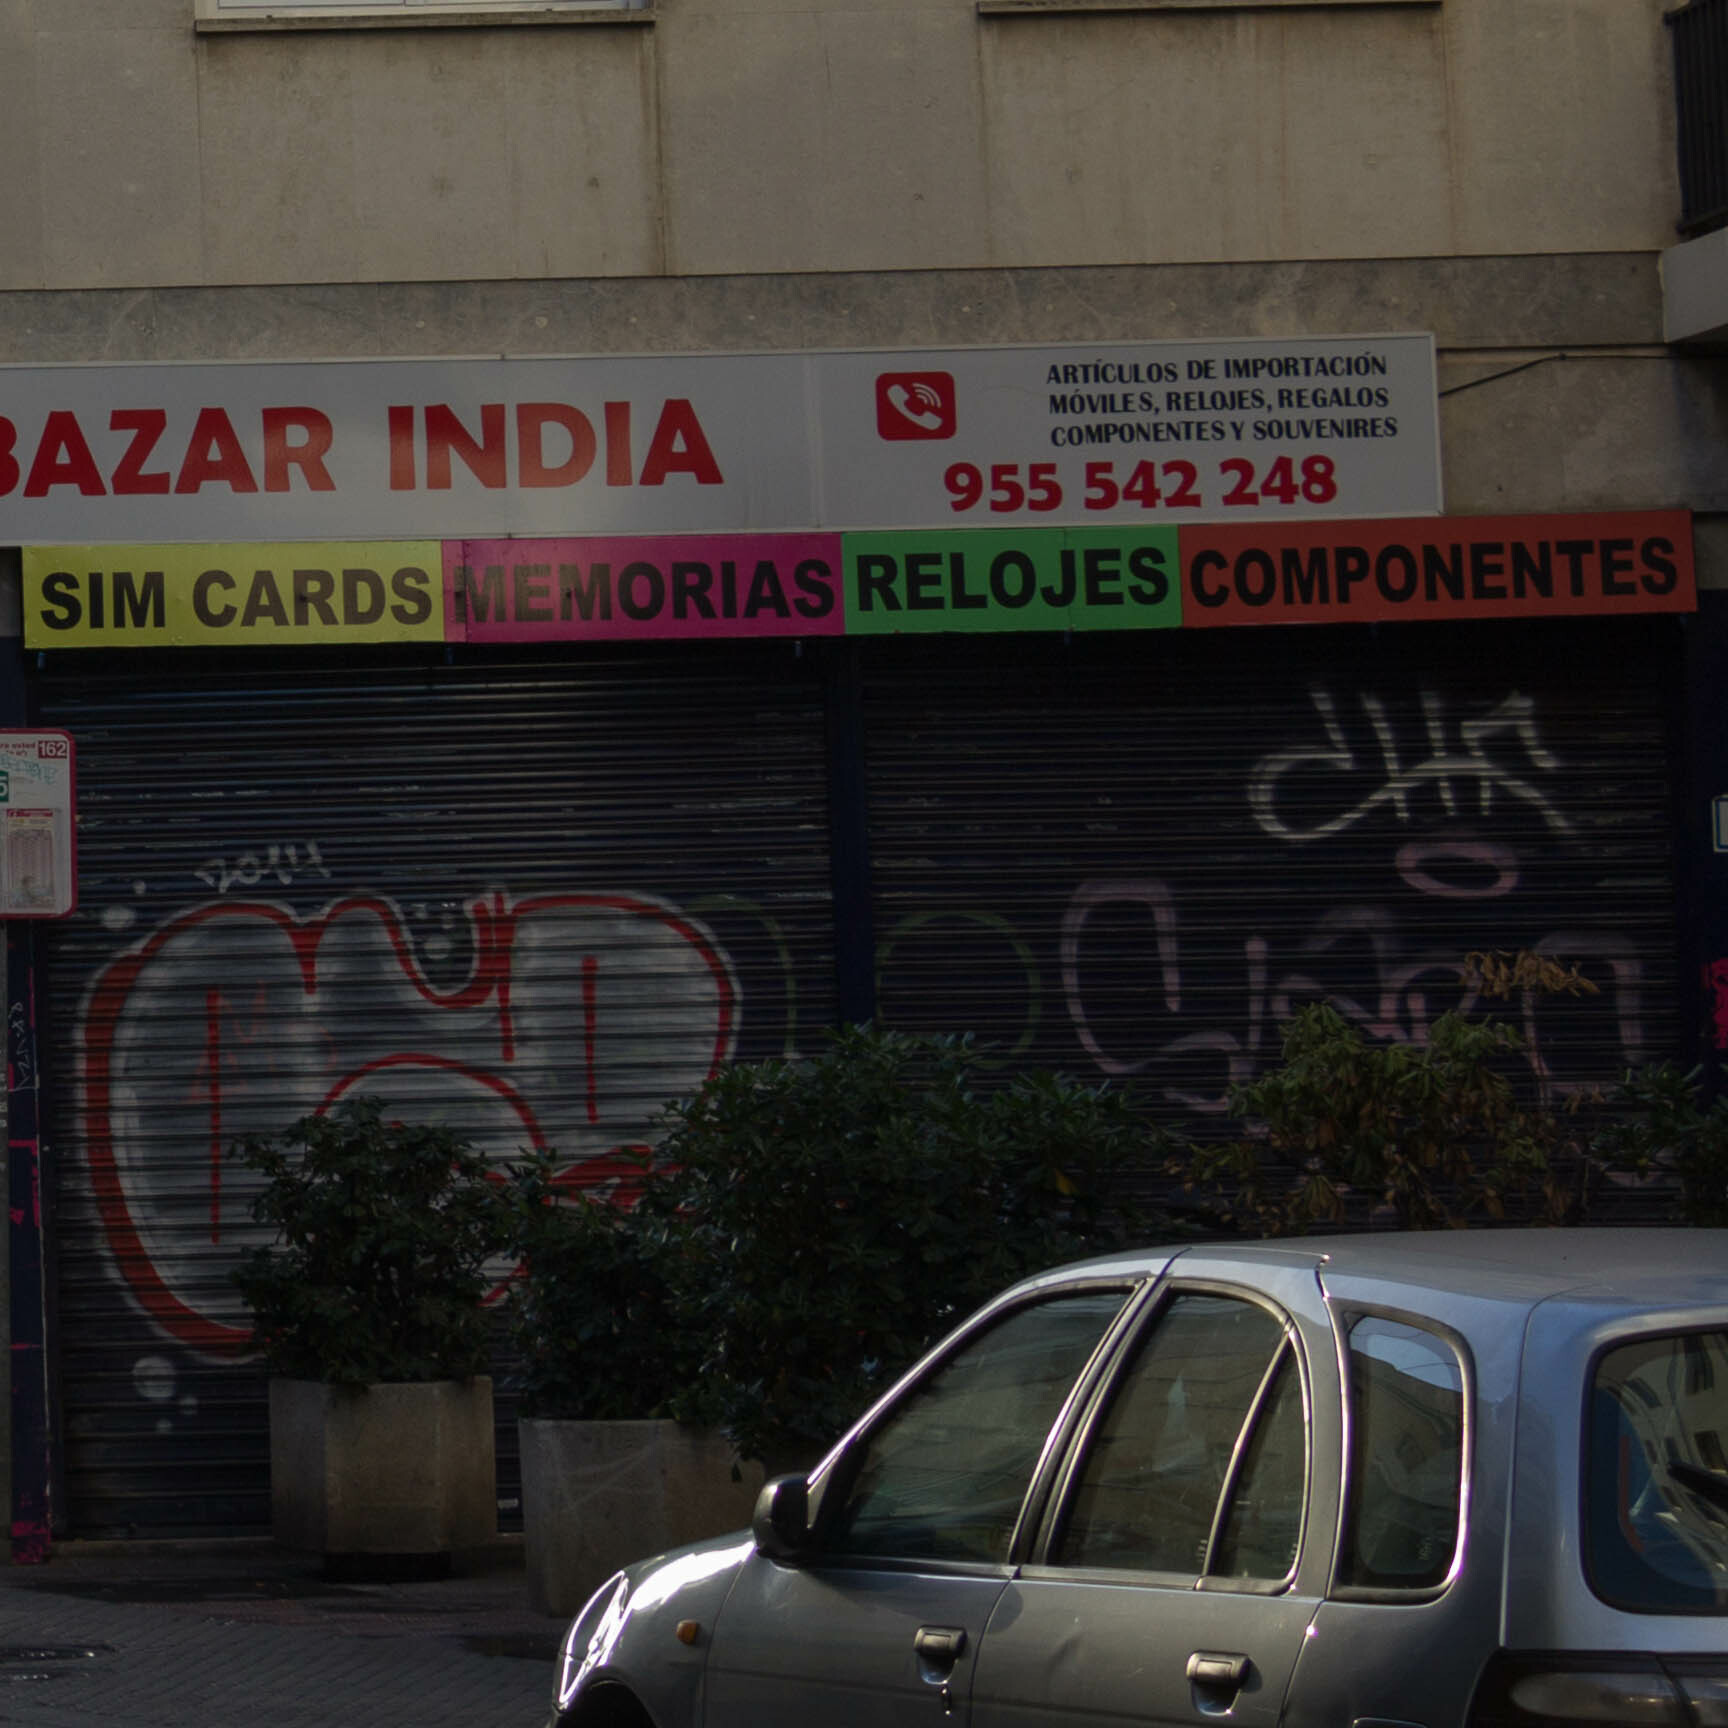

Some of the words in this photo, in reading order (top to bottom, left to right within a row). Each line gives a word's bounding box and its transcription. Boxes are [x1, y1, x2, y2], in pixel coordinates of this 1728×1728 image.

[1047, 355, 1179, 387] ARTÍCULOS
[1186, 358, 1215, 383] DE
[1224, 350, 1388, 381] IMPORTACIÓN
[1049, 387, 1160, 417] MÓVILES,
[1166, 388, 1273, 415] RELOJES,
[1277, 385, 1390, 411] REGALOS
[1050, 419, 1226, 449] COMPONENTES
[1229, 420, 1246, 441] Y
[1252, 414, 1399, 442] SOUVENIRES
[387, 398, 724, 492] INDIA
[943, 462, 1064, 512] 955
[1084, 458, 1200, 509] 542
[1219, 454, 1340, 507] 248
[39, 571, 166, 631] SIM
[191, 565, 433, 629] CARDS
[452, 558, 838, 624] MEMORIAS
[859, 544, 1172, 612] RELOJES
[1191, 534, 1681, 609] COMPONENTES
[41, 741, 67, 758] 162
